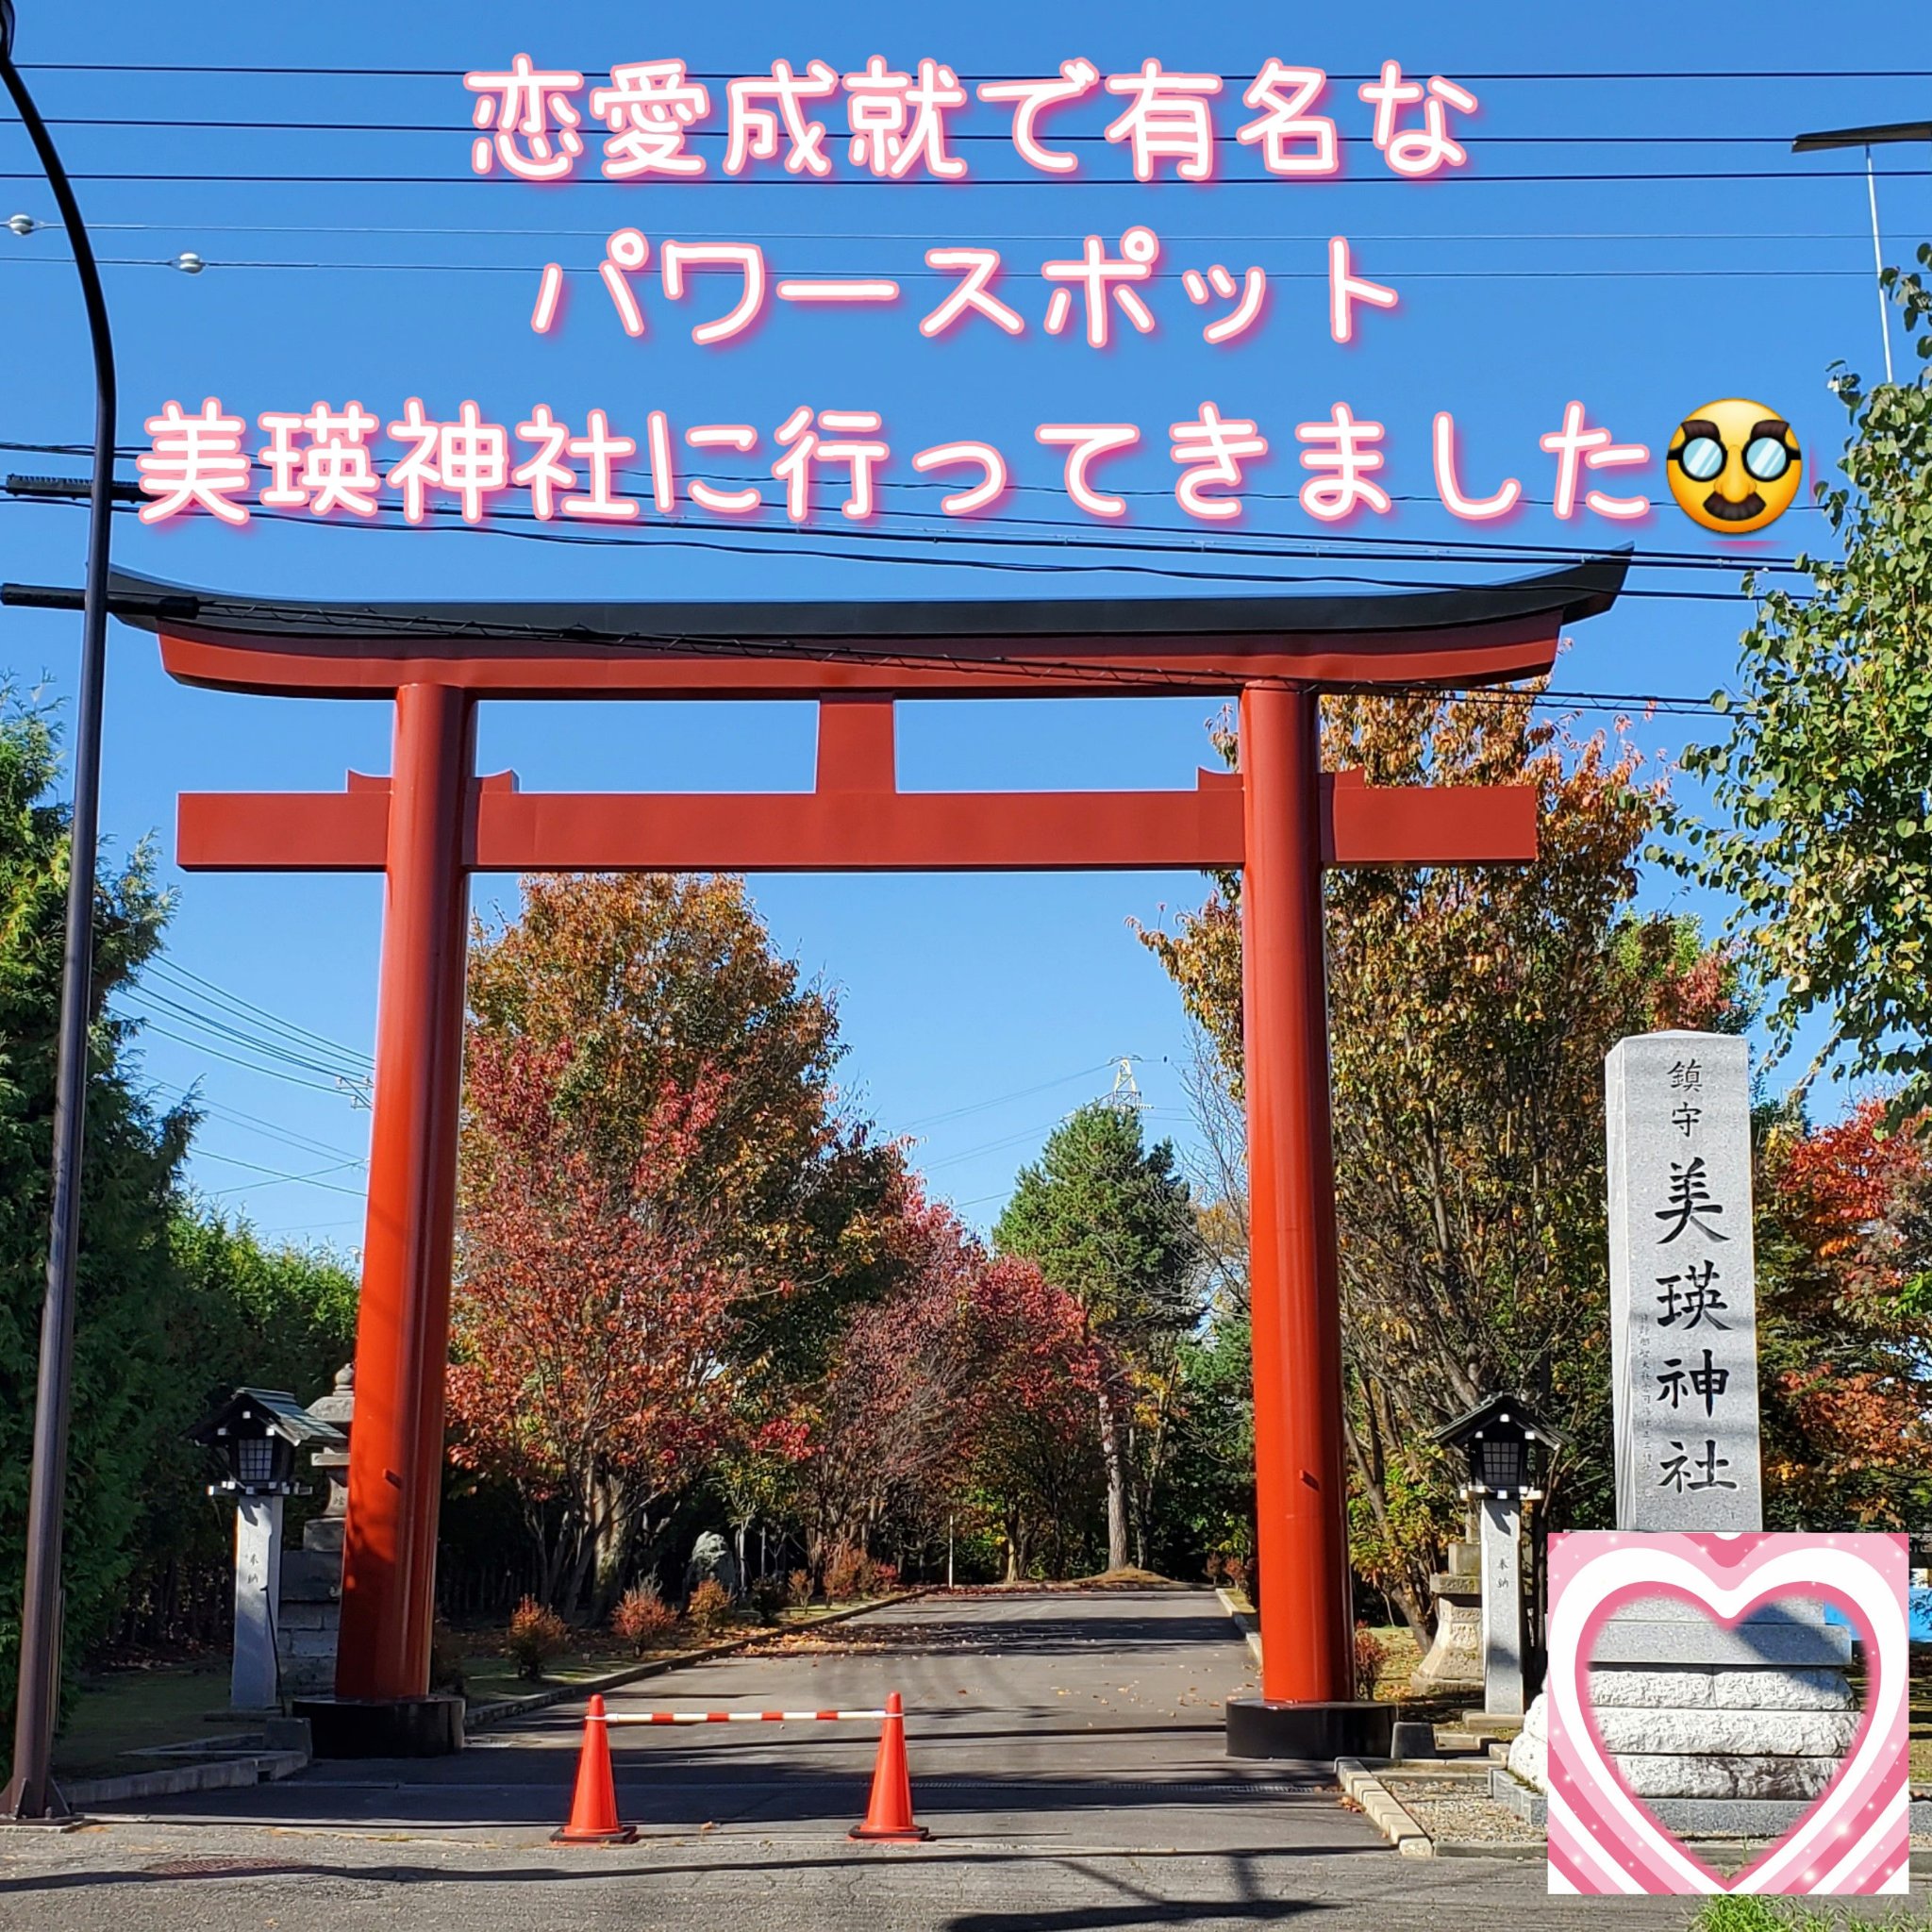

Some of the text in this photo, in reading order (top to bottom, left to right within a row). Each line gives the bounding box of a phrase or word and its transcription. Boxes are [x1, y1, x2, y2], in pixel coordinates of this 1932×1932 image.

[1654, 1059, 1739, 1494] 鎮守 美瑛神社
